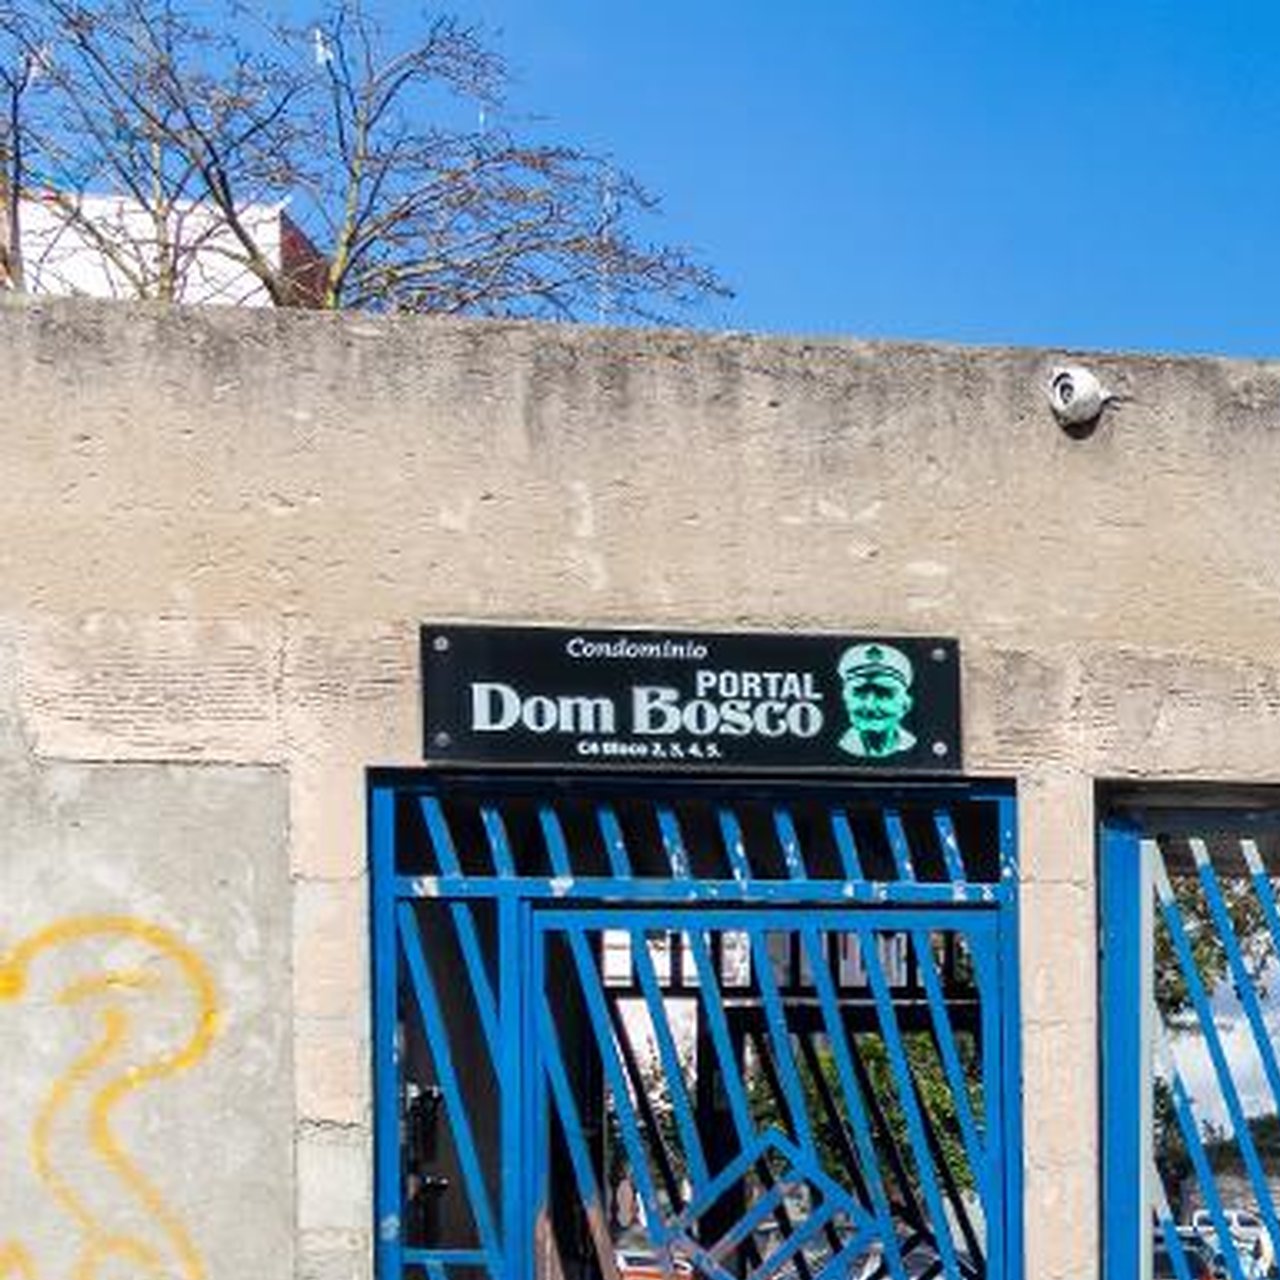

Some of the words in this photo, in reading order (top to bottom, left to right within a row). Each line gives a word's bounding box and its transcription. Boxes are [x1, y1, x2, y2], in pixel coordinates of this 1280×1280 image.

[695, 669, 824, 700] PORTAL
[470, 682, 616, 734] Dom
[631, 685, 824, 738] Bosco
